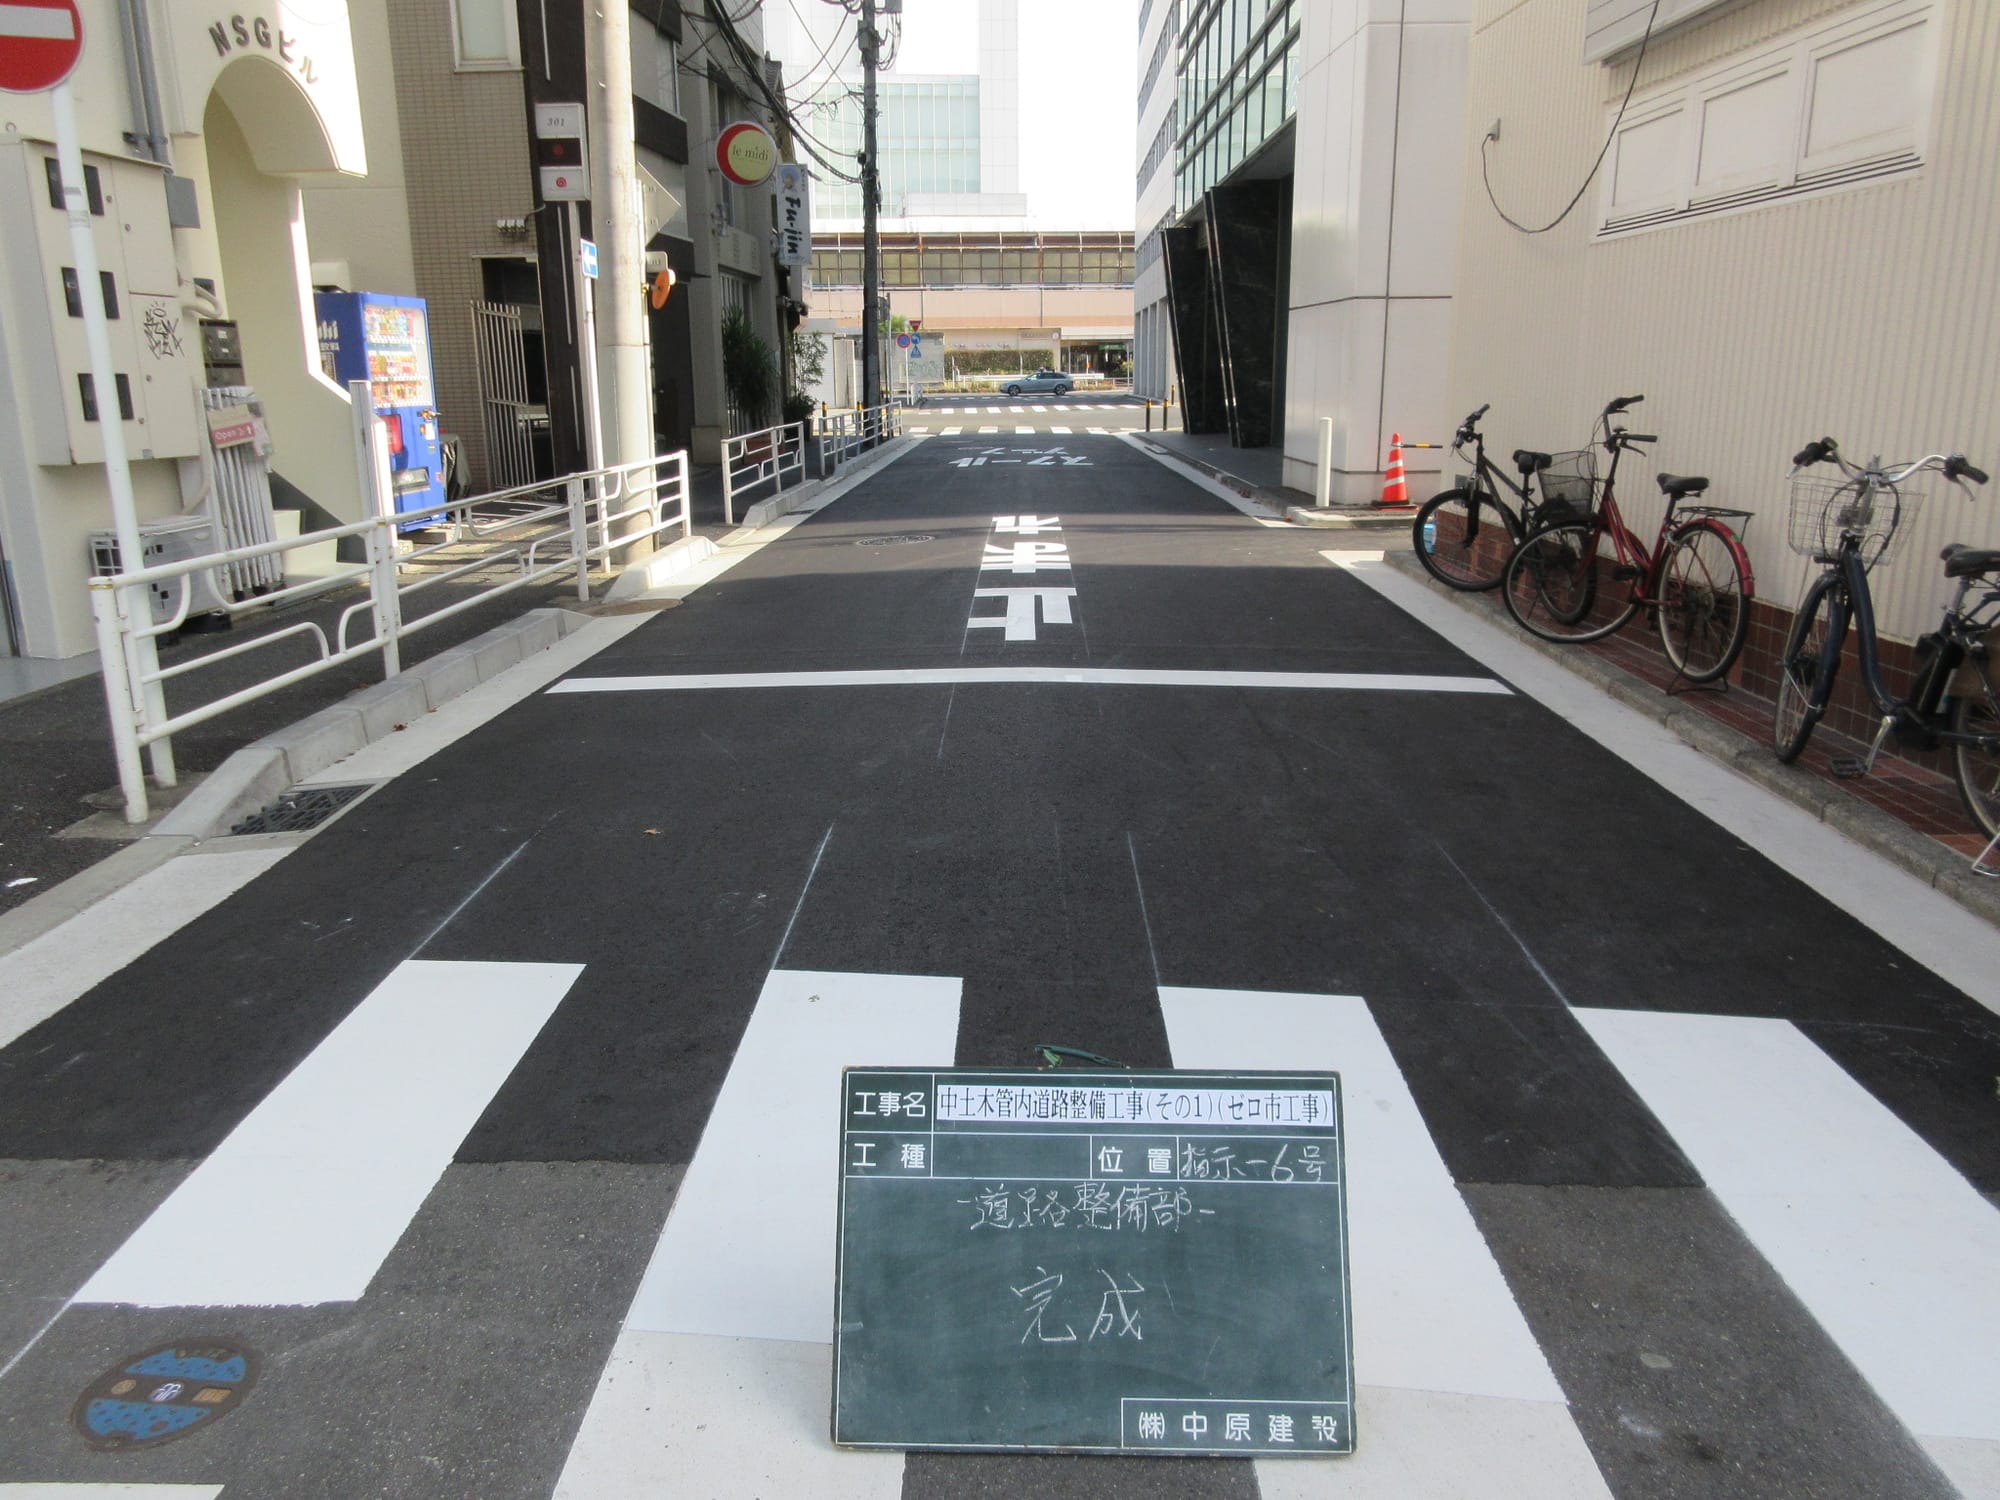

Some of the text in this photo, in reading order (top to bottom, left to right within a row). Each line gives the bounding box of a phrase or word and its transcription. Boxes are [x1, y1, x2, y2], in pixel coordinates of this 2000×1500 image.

[208, 14, 320, 85] NSGビル
[547, 117, 565, 127] 301
[732, 144, 742, 156] le
[745, 147, 769, 161] midi
[948, 456, 1094, 468] スクール
[967, 515, 1077, 641] 止まれ
[853, 1091, 926, 1118] 工事名
[1010, 1266, 1145, 1345] 完成
